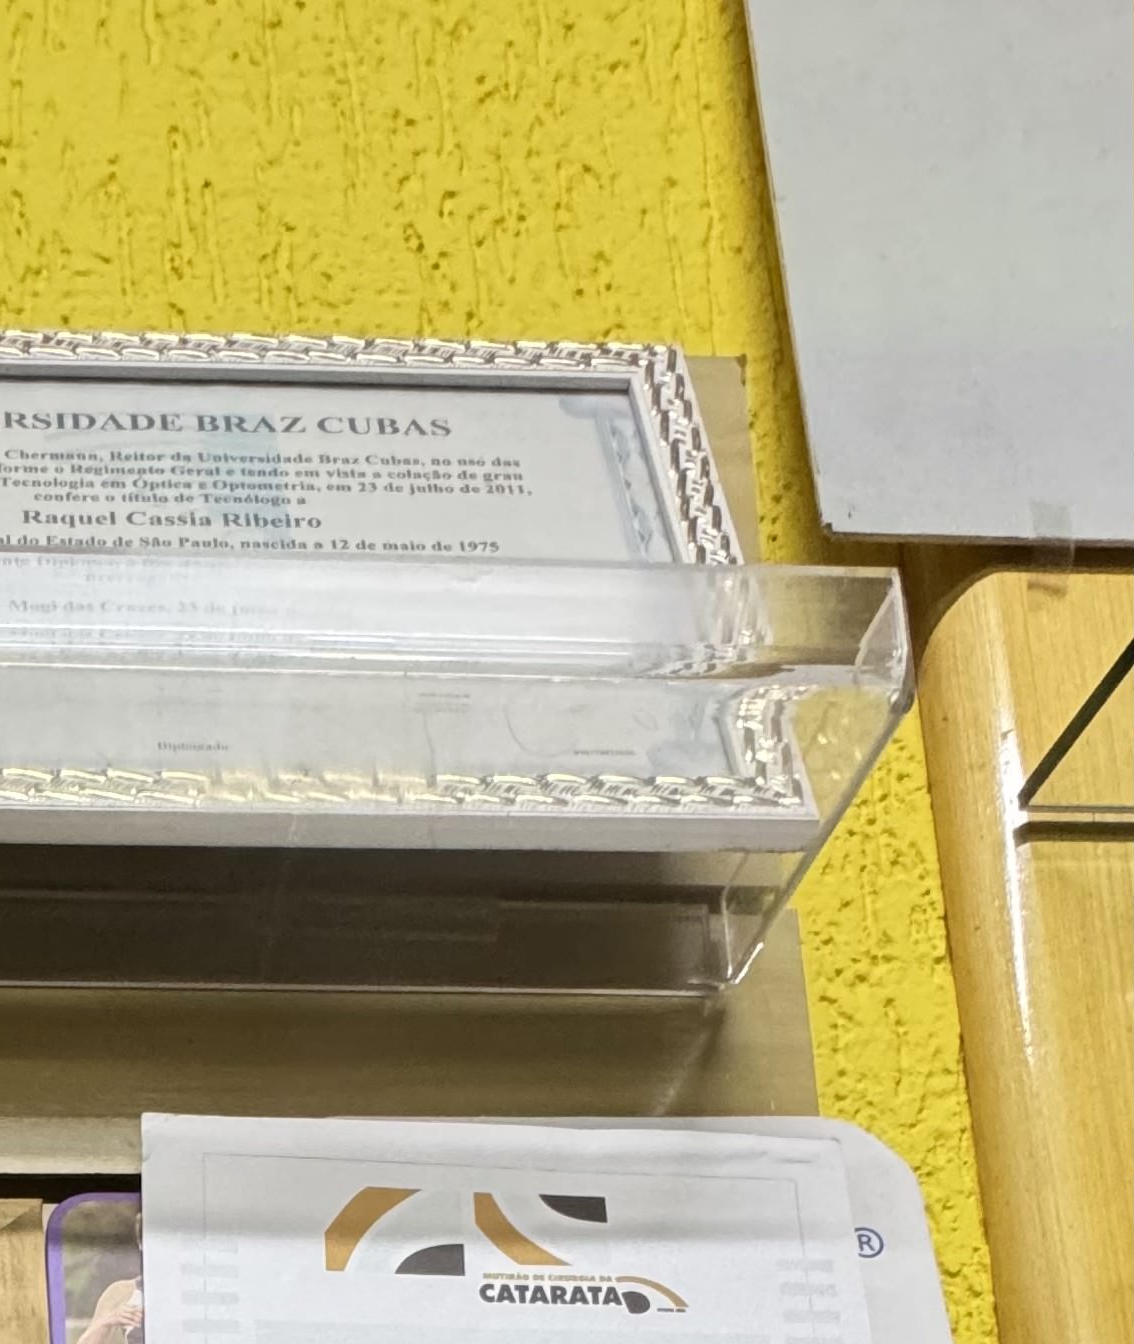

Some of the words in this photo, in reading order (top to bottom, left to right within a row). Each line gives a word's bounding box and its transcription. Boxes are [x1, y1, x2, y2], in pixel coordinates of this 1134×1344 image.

[195, 414, 307, 434] BRAZ
[316, 416, 452, 437] CUBAS
[22, 509, 117, 529] Raquel
[125, 510, 212, 527] Cassia
[221, 512, 322, 529] Ribeiro
[479, 1283, 623, 1305] CATARATA
